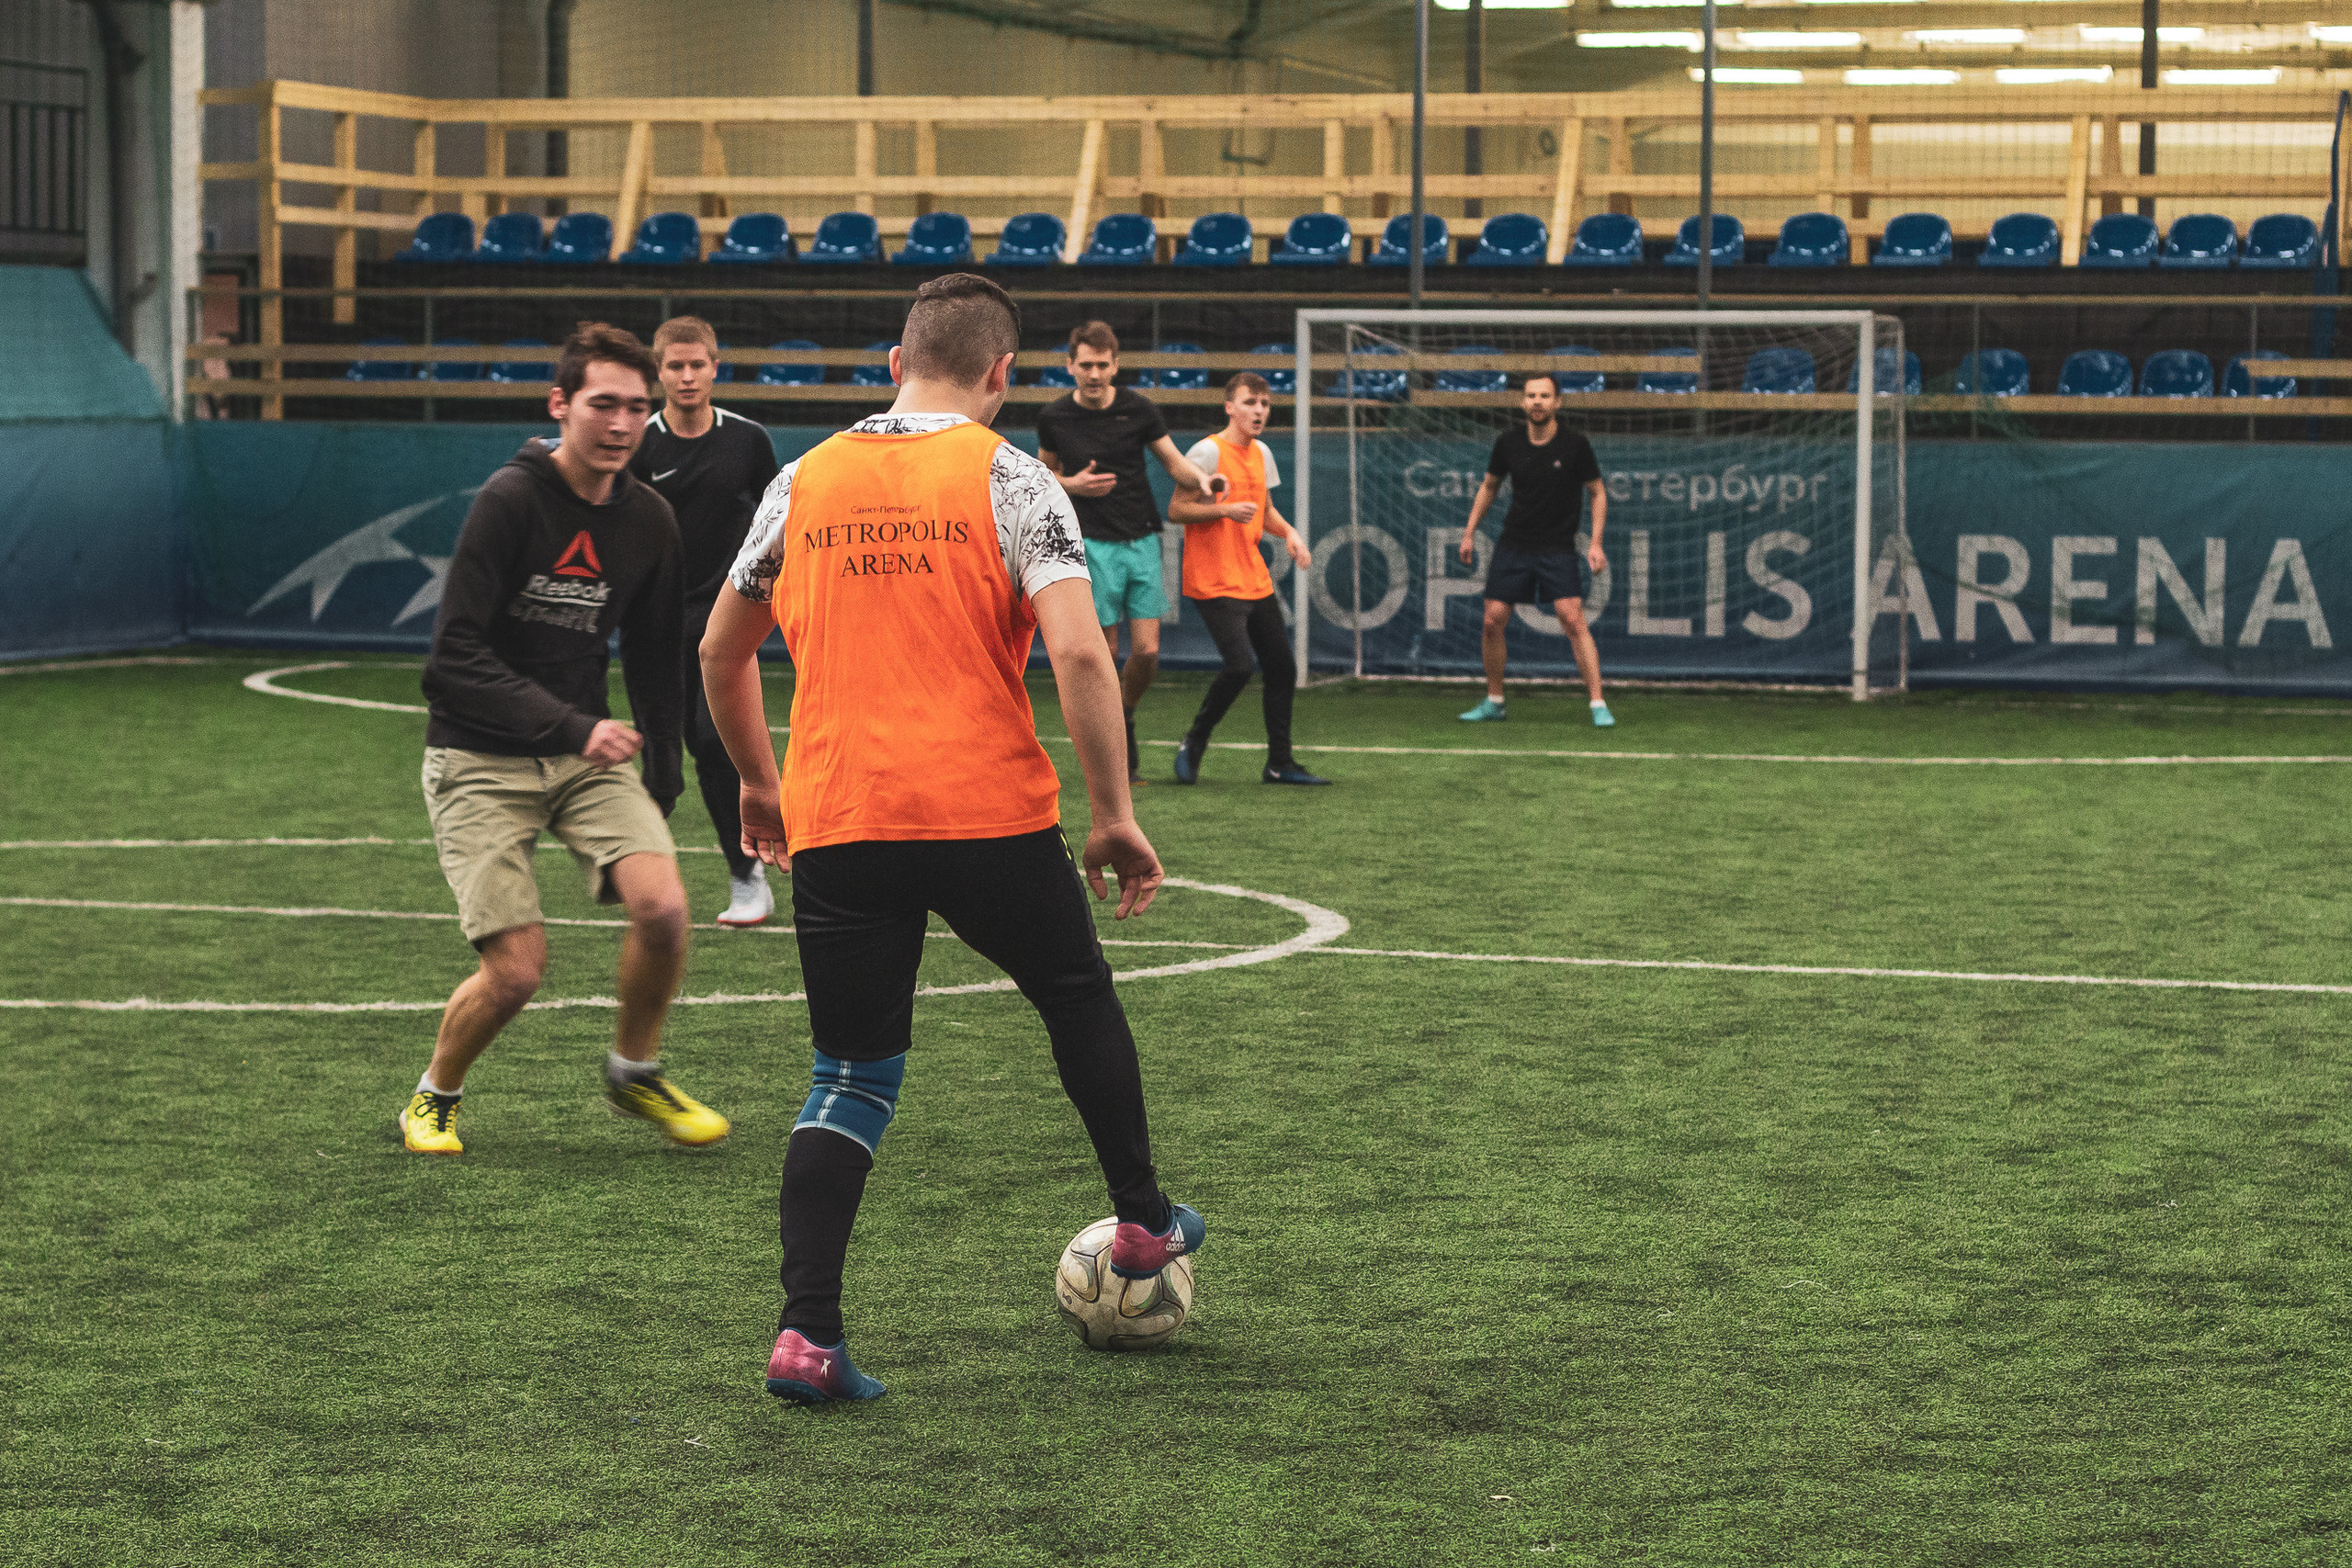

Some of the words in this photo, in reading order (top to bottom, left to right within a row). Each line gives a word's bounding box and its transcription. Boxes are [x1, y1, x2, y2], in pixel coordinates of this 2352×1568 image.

[850, 505, 921, 515] Санкт-Петербург
[804, 519, 969, 553] METROPOLIS
[841, 552, 934, 578] ARENA
[1850, 533, 2334, 648] ARENA
